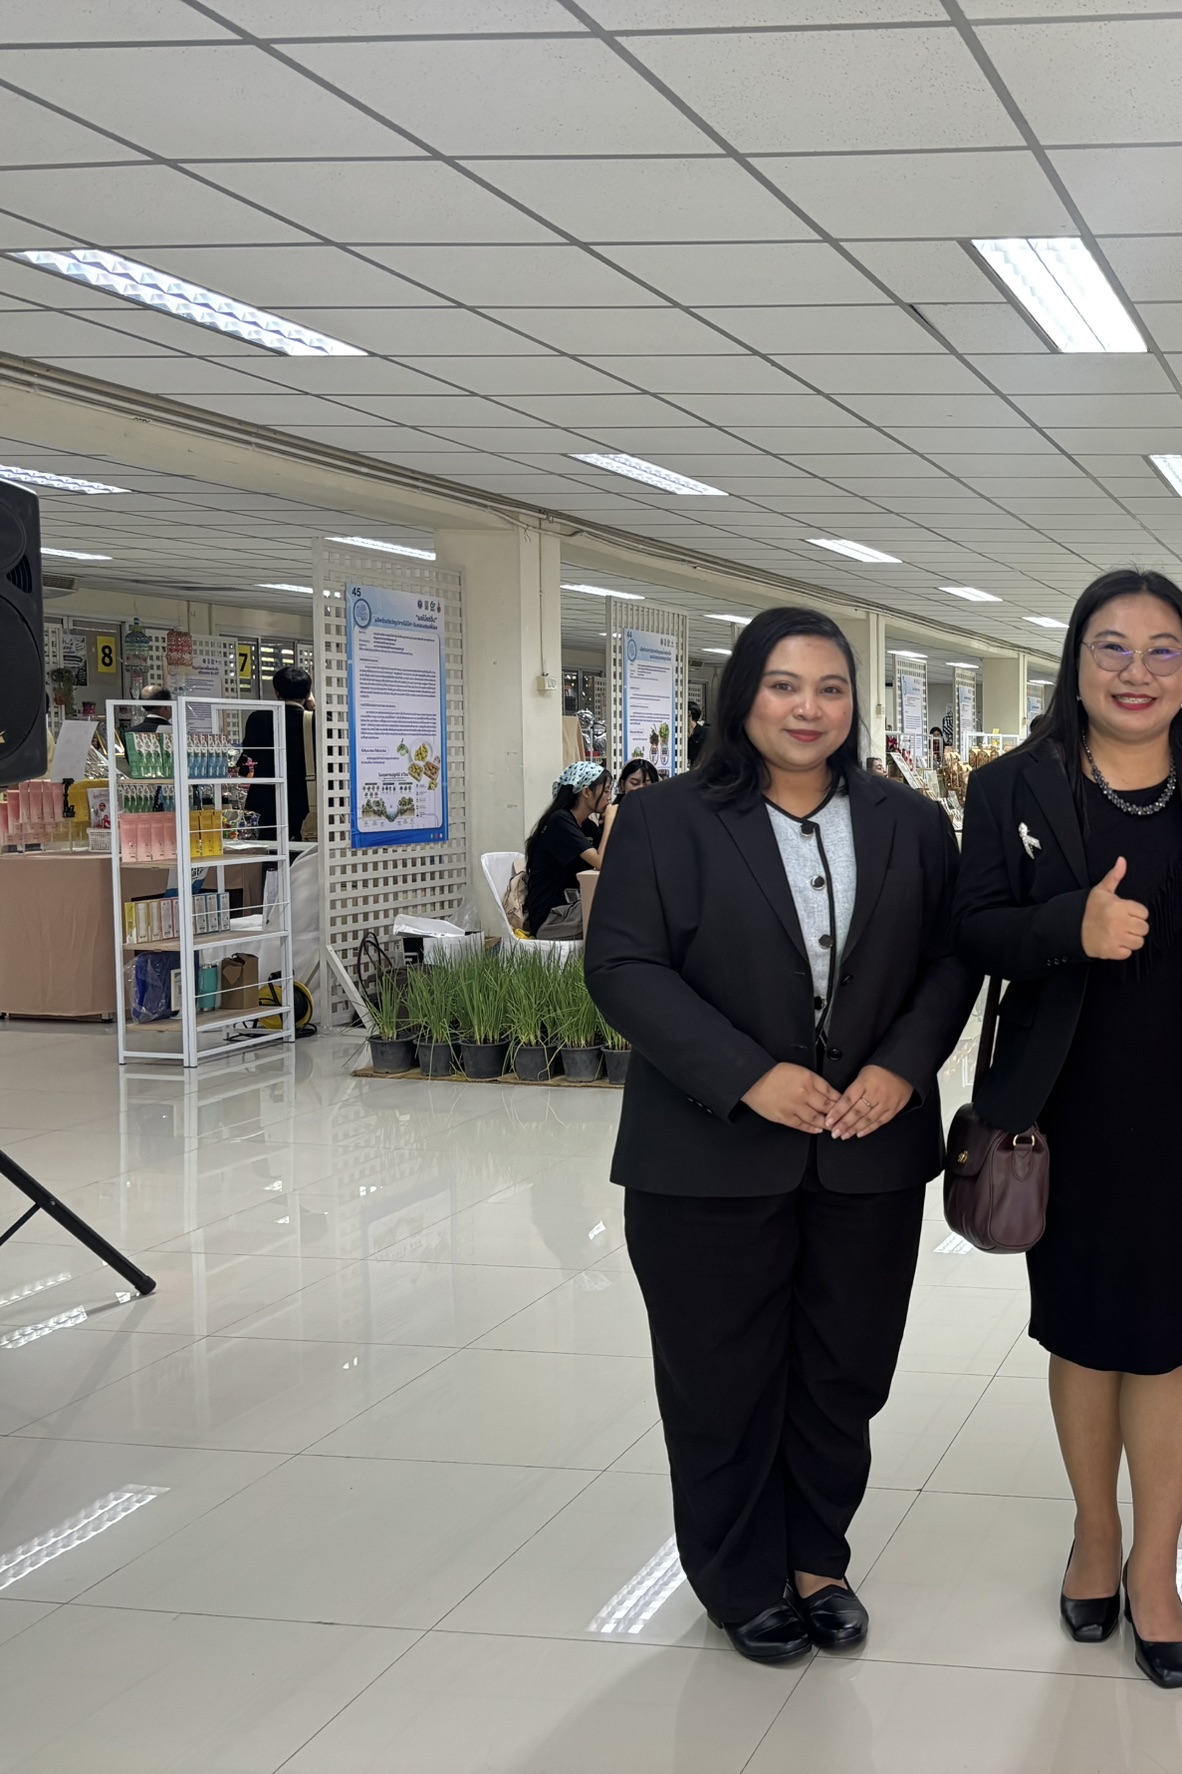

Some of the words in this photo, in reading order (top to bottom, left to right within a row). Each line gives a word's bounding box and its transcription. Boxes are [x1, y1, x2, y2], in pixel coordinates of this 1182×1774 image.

[352, 587, 362, 597] 45
[101, 645, 114, 667] 8
[239, 653, 248, 672] 7
